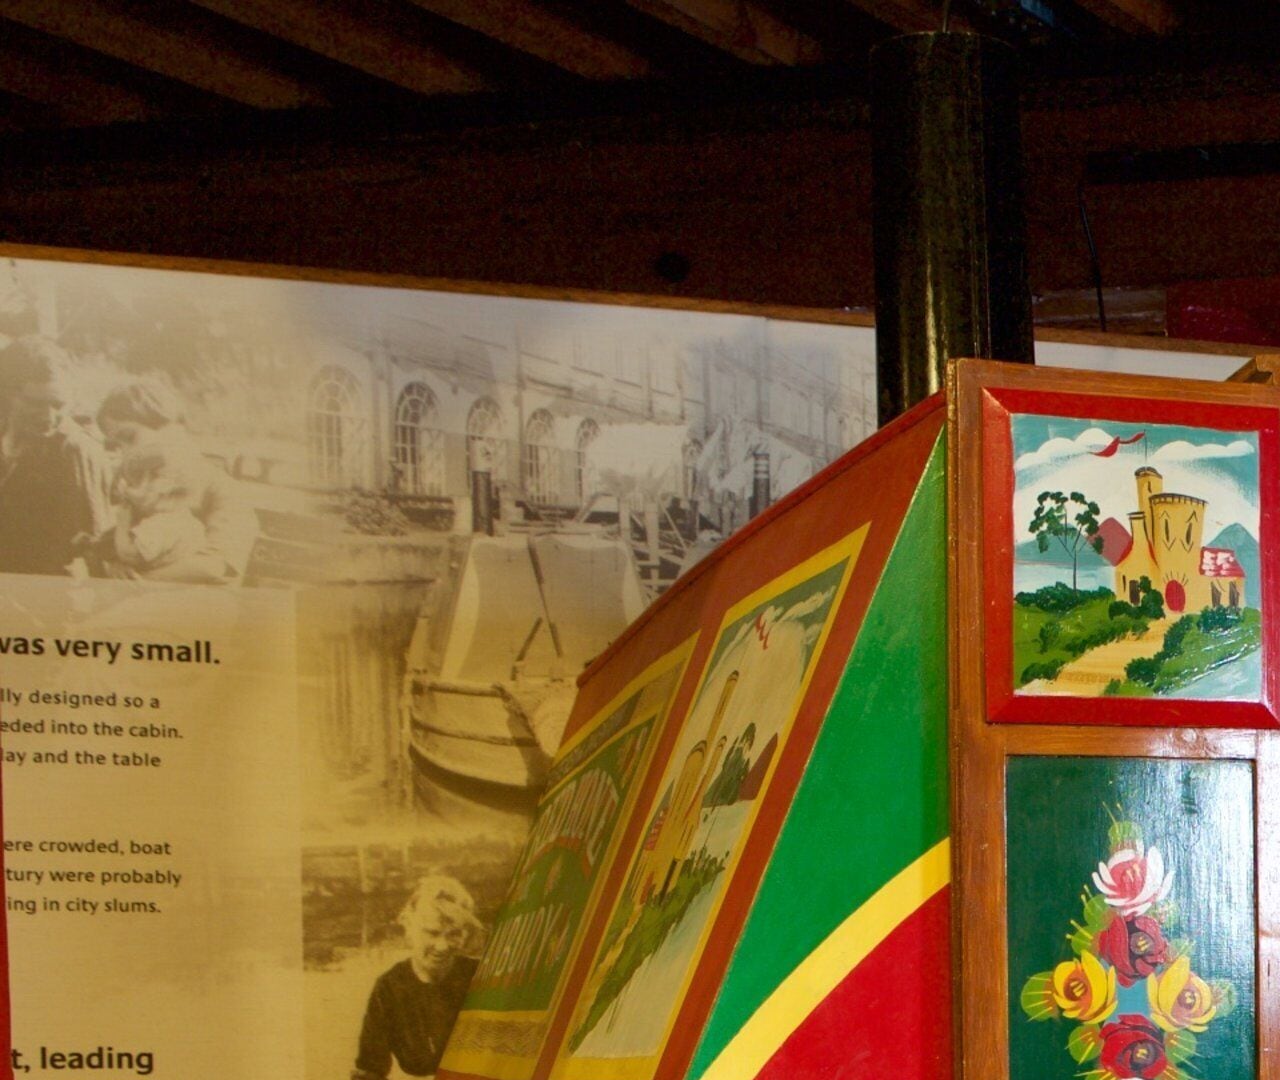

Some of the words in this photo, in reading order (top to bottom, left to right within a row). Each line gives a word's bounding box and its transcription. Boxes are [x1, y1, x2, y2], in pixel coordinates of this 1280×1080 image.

[55, 639, 121, 664] very
[131, 640, 220, 664] small.
[29, 690, 117, 709] designed
[124, 695, 143, 708] so
[150, 697, 160, 709] a
[51, 720, 88, 735] into
[94, 723, 124, 737] the
[129, 724, 183, 739] cabin.
[0, 747, 26, 766] ay
[33, 750, 68, 764] and
[75, 751, 106, 765] the
[113, 752, 161, 767] table
[39, 839, 124, 855] crowded,
[130, 840, 171, 855] boat
[49, 870, 95, 882] were
[101, 869, 181, 886] probably
[43, 897, 60, 911] in
[66, 897, 98, 915] city
[104, 898, 161, 913] slums.
[41, 1046, 154, 1075] leading
